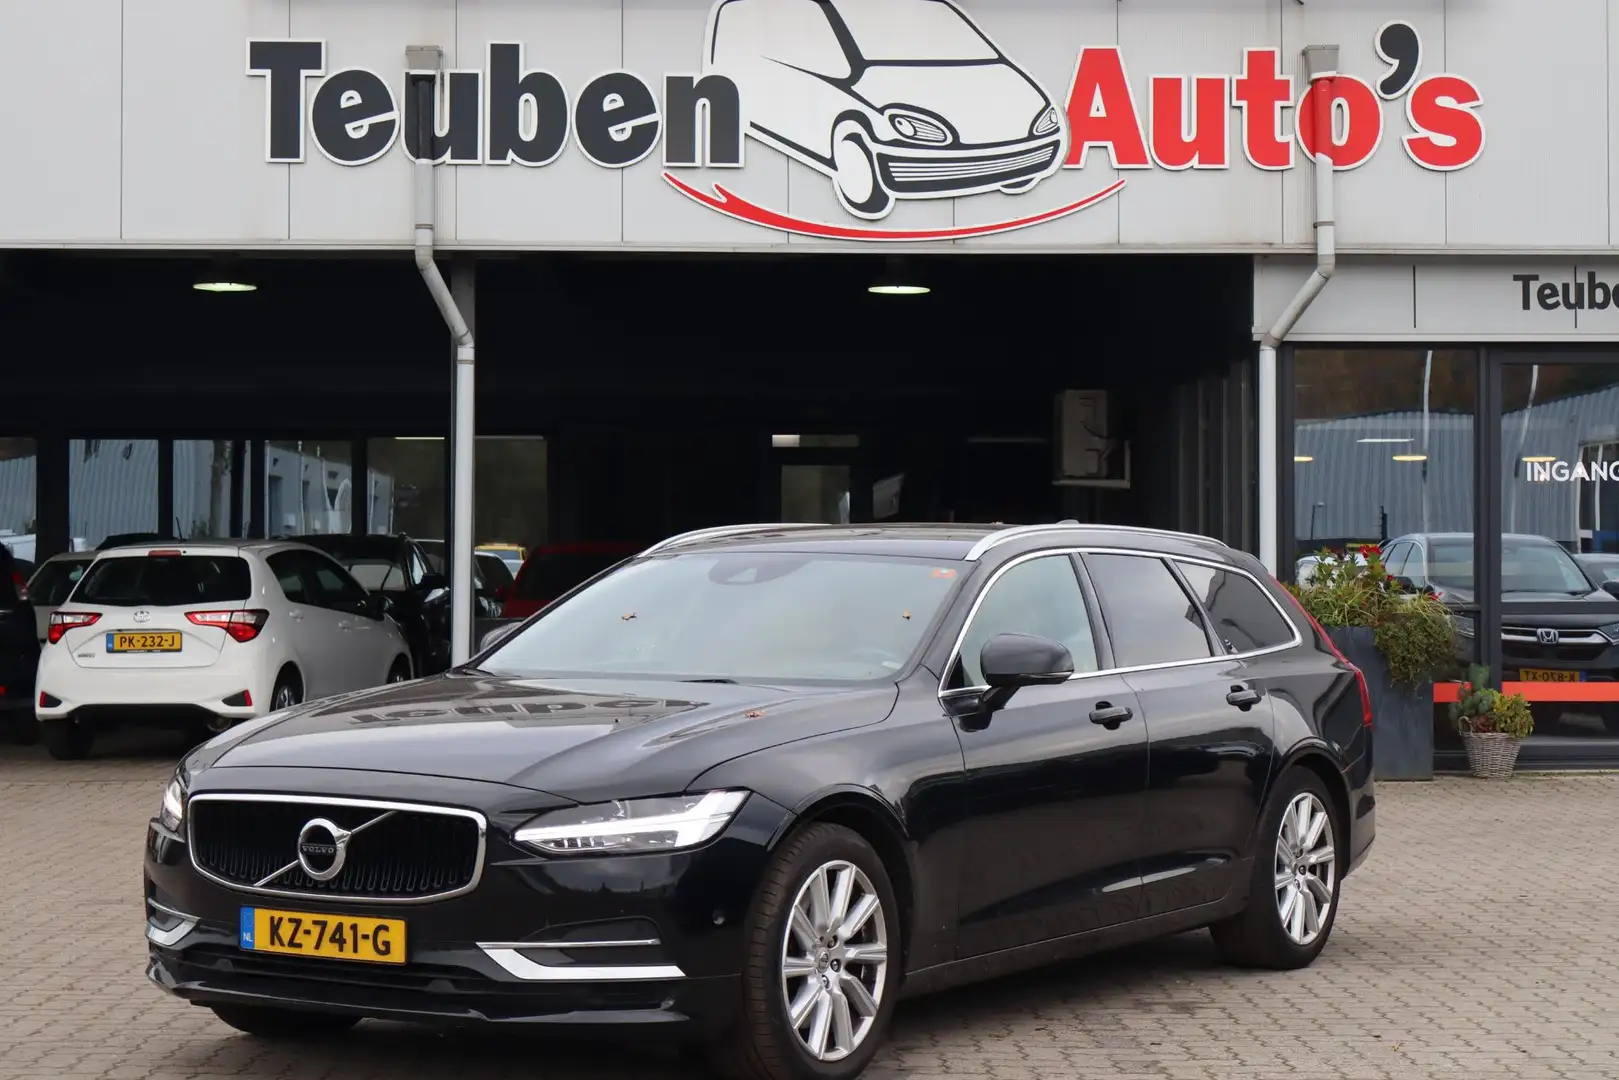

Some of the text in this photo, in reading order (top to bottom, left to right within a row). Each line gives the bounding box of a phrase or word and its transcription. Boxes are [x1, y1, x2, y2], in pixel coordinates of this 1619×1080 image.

[247, 39, 743, 167] Teuben
[1065, 21, 1484, 170] Auto's
[119, 635, 175, 648] PK-232-J
[302, 845, 335, 853] VOLVO
[243, 932, 253, 943] NL
[269, 916, 391, 956] KZ-741-G
